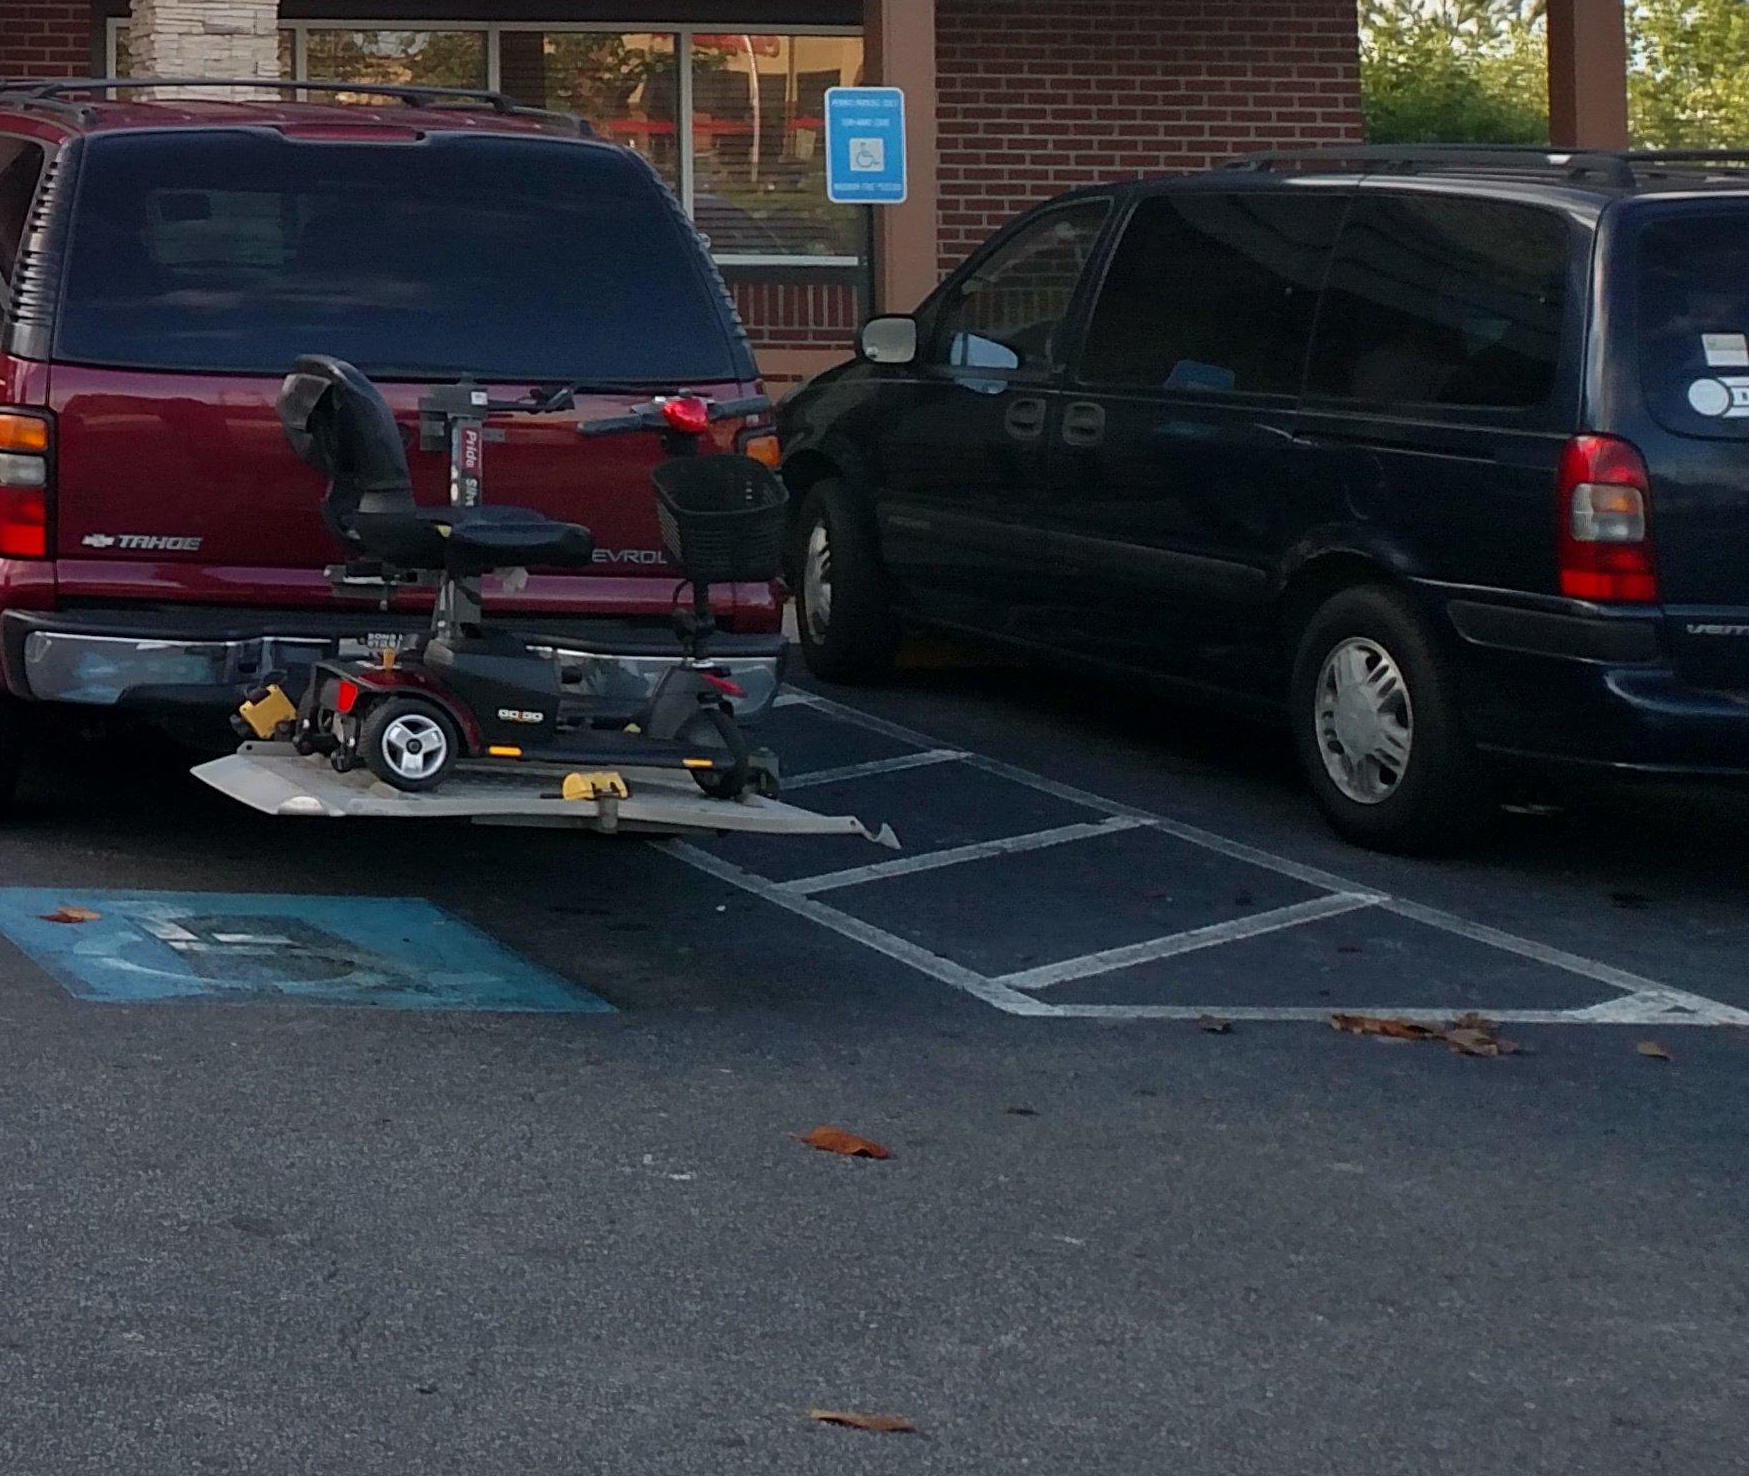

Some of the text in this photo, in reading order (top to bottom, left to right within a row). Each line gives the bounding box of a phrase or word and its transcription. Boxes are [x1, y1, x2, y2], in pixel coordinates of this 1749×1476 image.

[466, 430, 478, 468] Pride
[119, 534, 203, 550] TAHOE
[592, 549, 668, 564] EVROL
